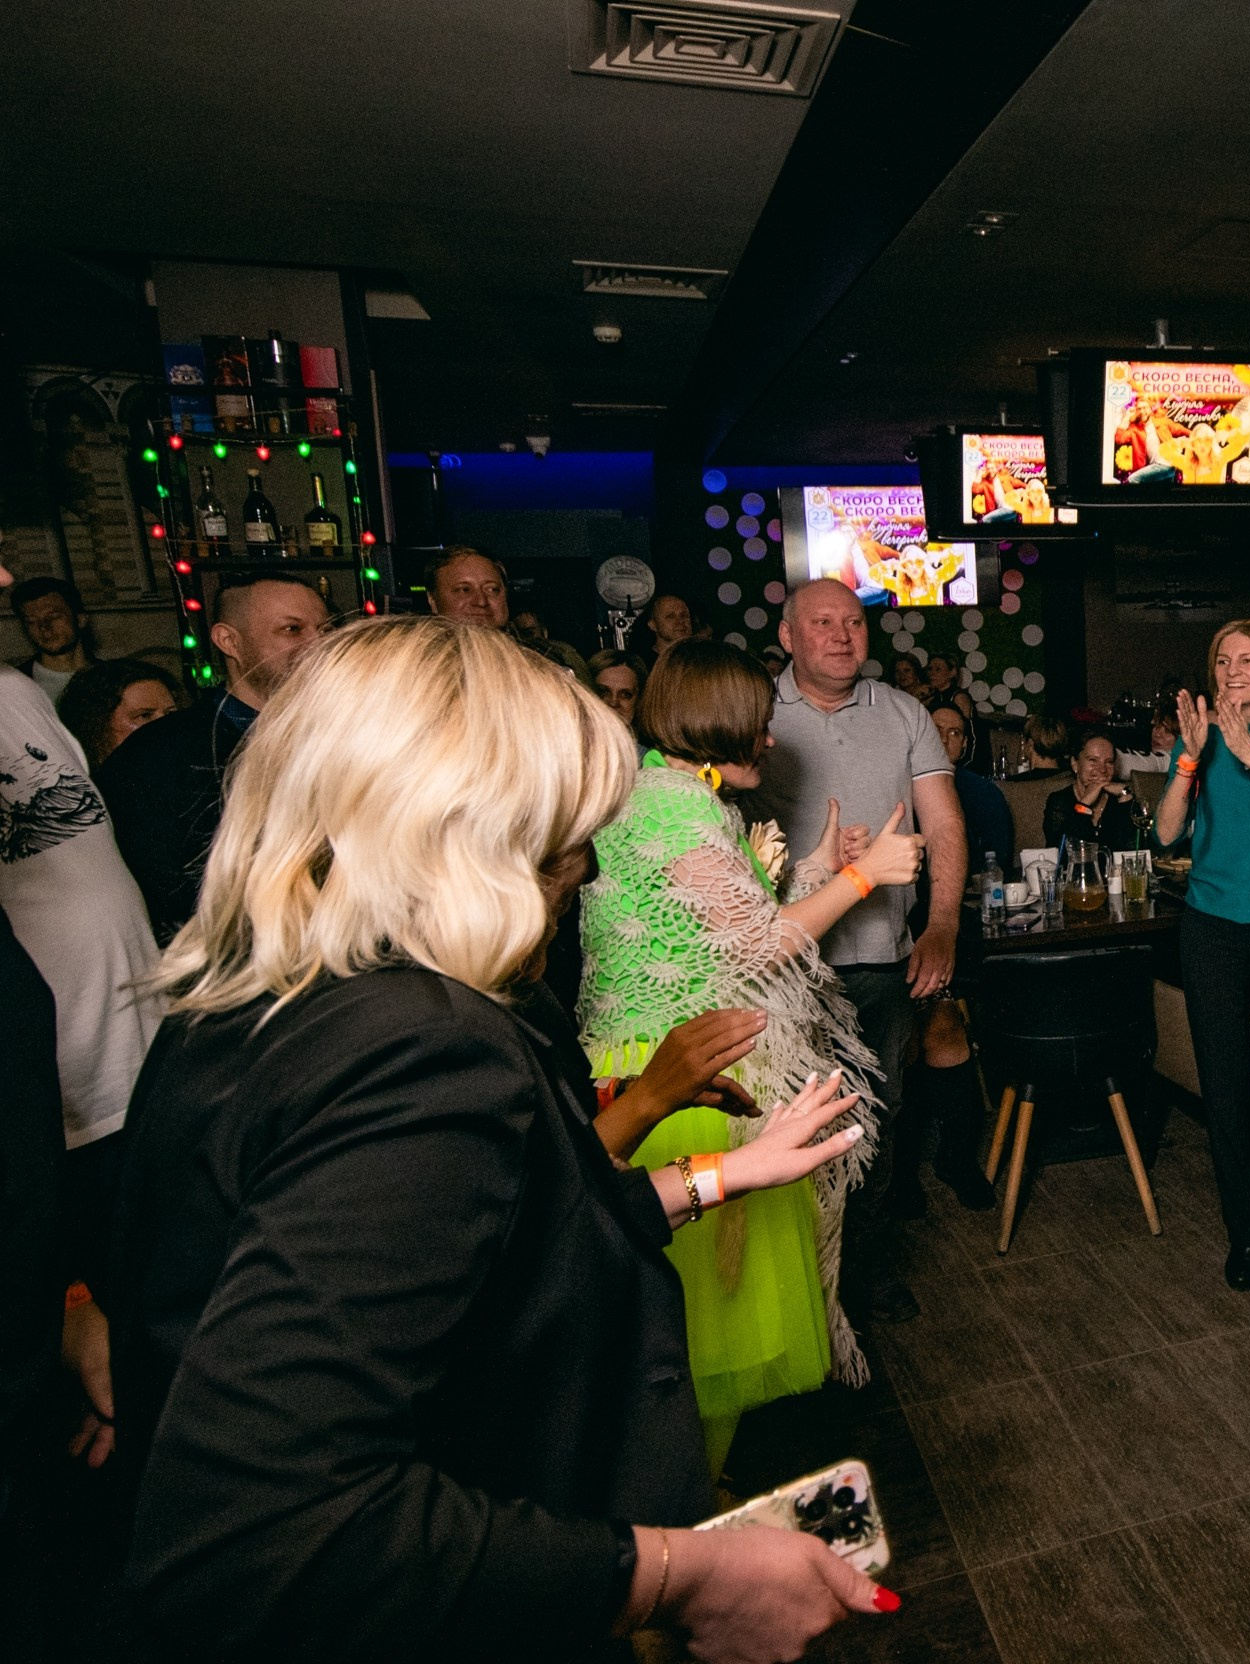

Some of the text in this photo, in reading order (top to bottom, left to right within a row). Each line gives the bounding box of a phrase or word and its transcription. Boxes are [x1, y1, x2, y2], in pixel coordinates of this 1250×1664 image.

[1132, 372, 1235, 385] СКОРО ВЕСНА,
[1111, 387, 1126, 396] 22
[1143, 383, 1191, 393] СКОРО
[832, 496, 883, 506] СКОРО
[812, 511, 828, 521] 22
[845, 507, 895, 516] СКОРО
